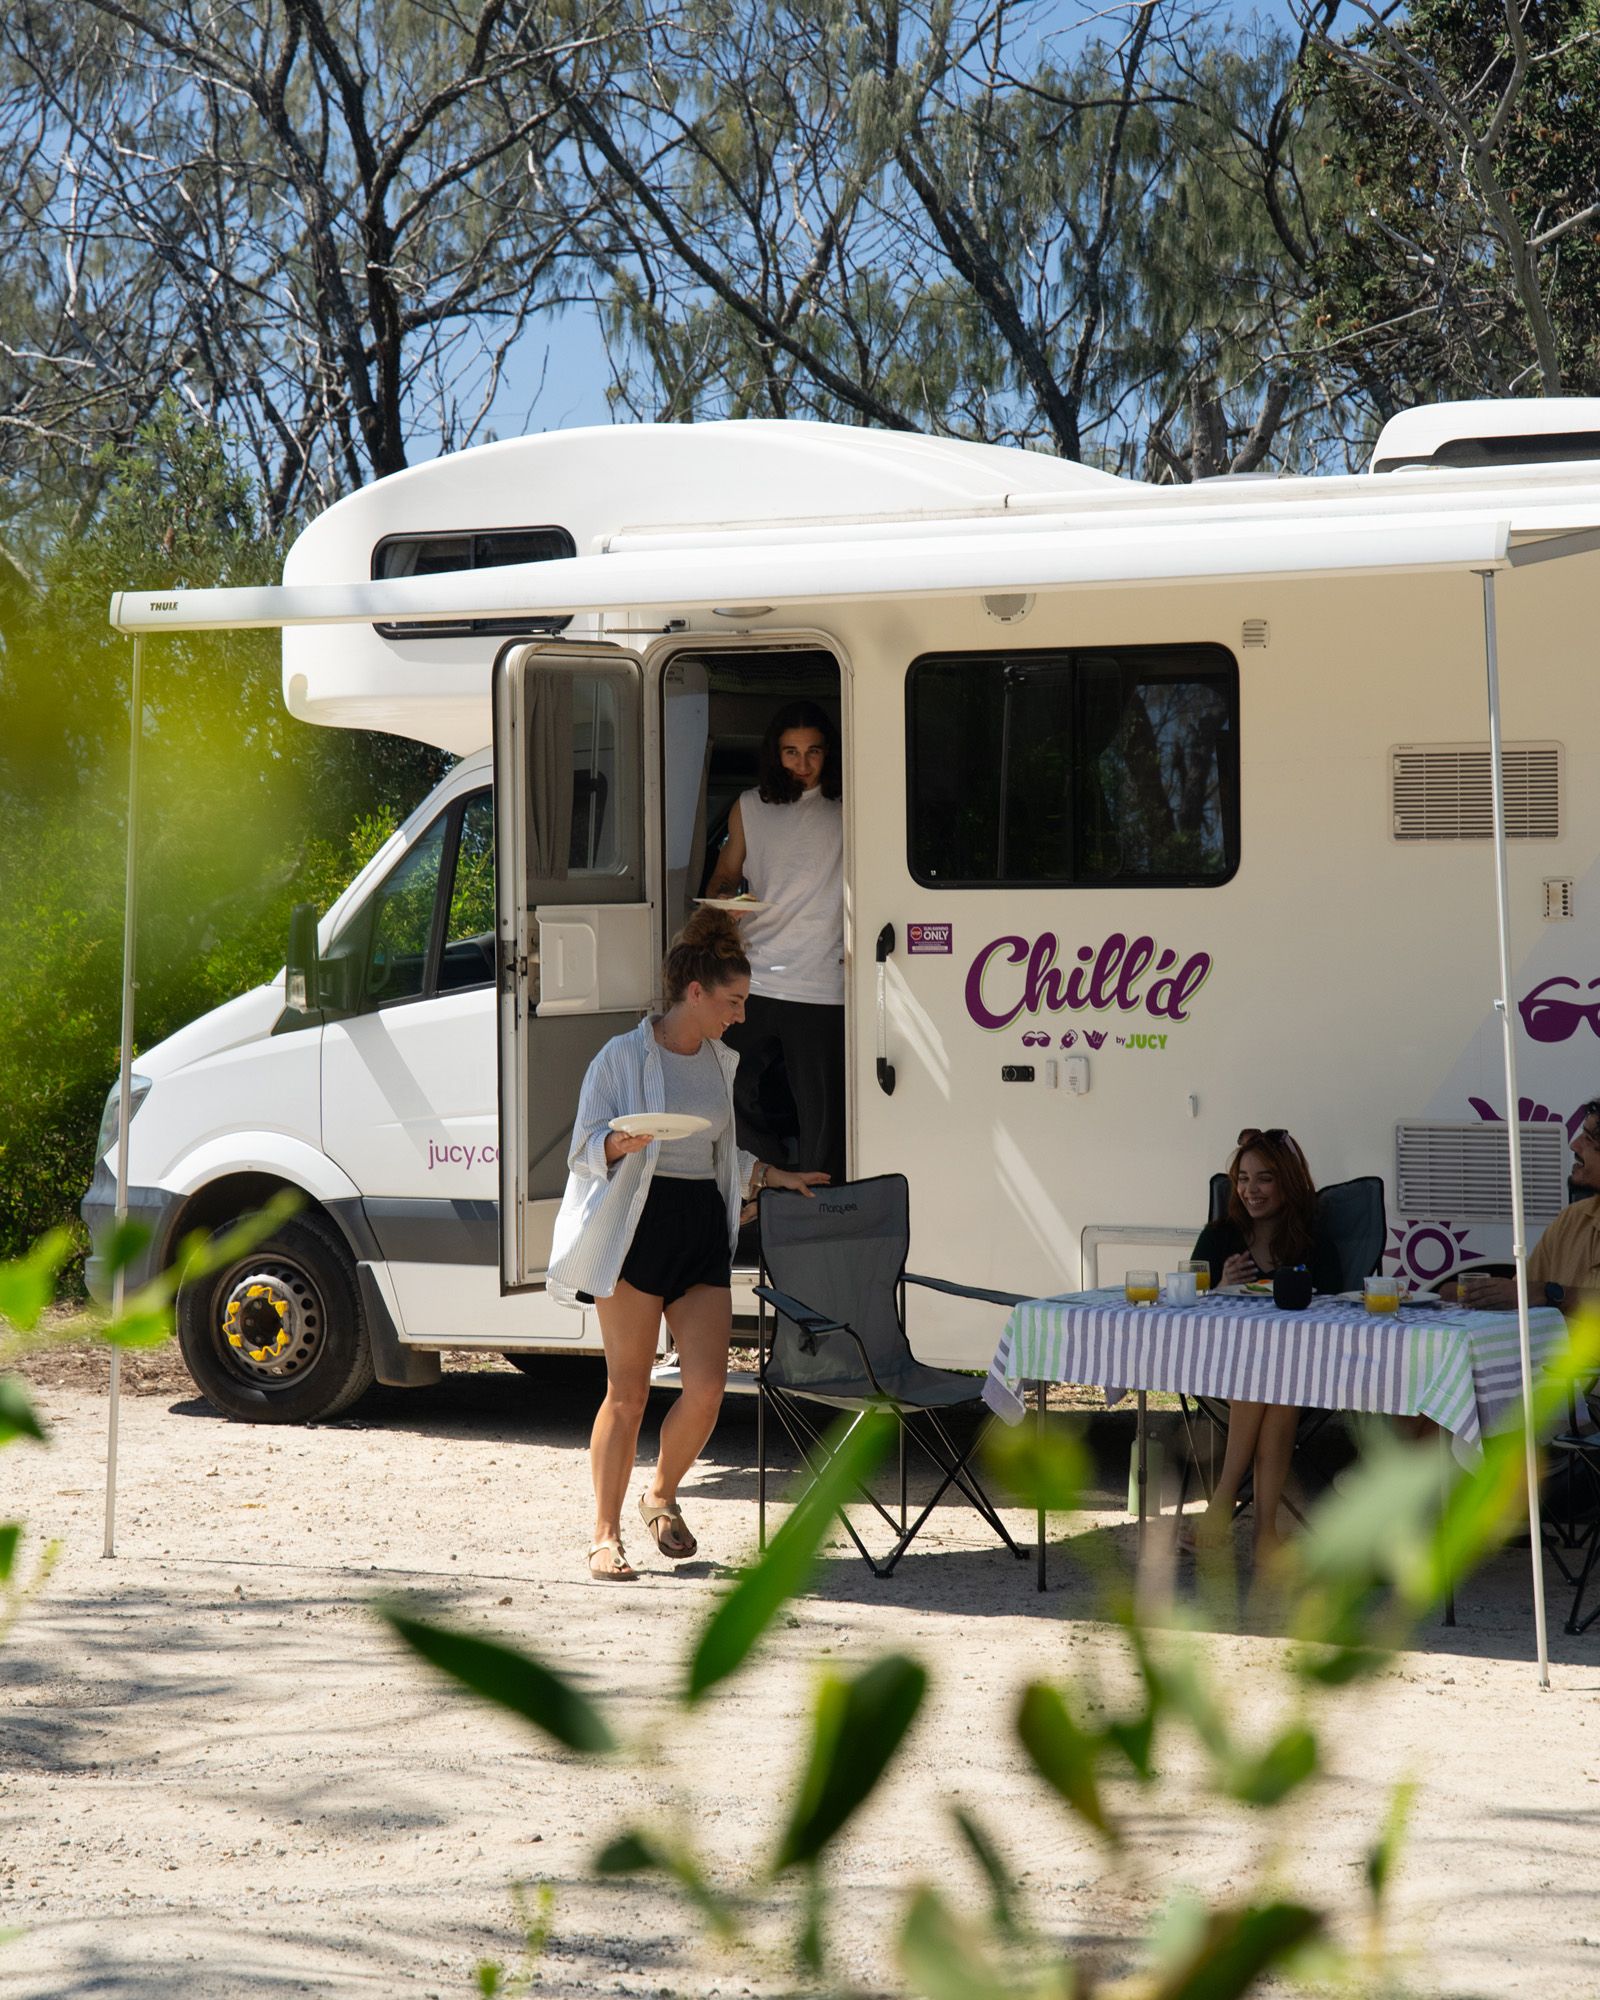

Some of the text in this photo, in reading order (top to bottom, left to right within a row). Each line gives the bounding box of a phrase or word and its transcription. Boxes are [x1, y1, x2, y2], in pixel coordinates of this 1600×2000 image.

[150, 602, 178, 611] THULE
[923, 931, 949, 941] ONLY
[965, 932, 1211, 1030] Chill'd
[1116, 1034, 1168, 1050] by JUCY
[428, 1139, 499, 1170] jucy.c
